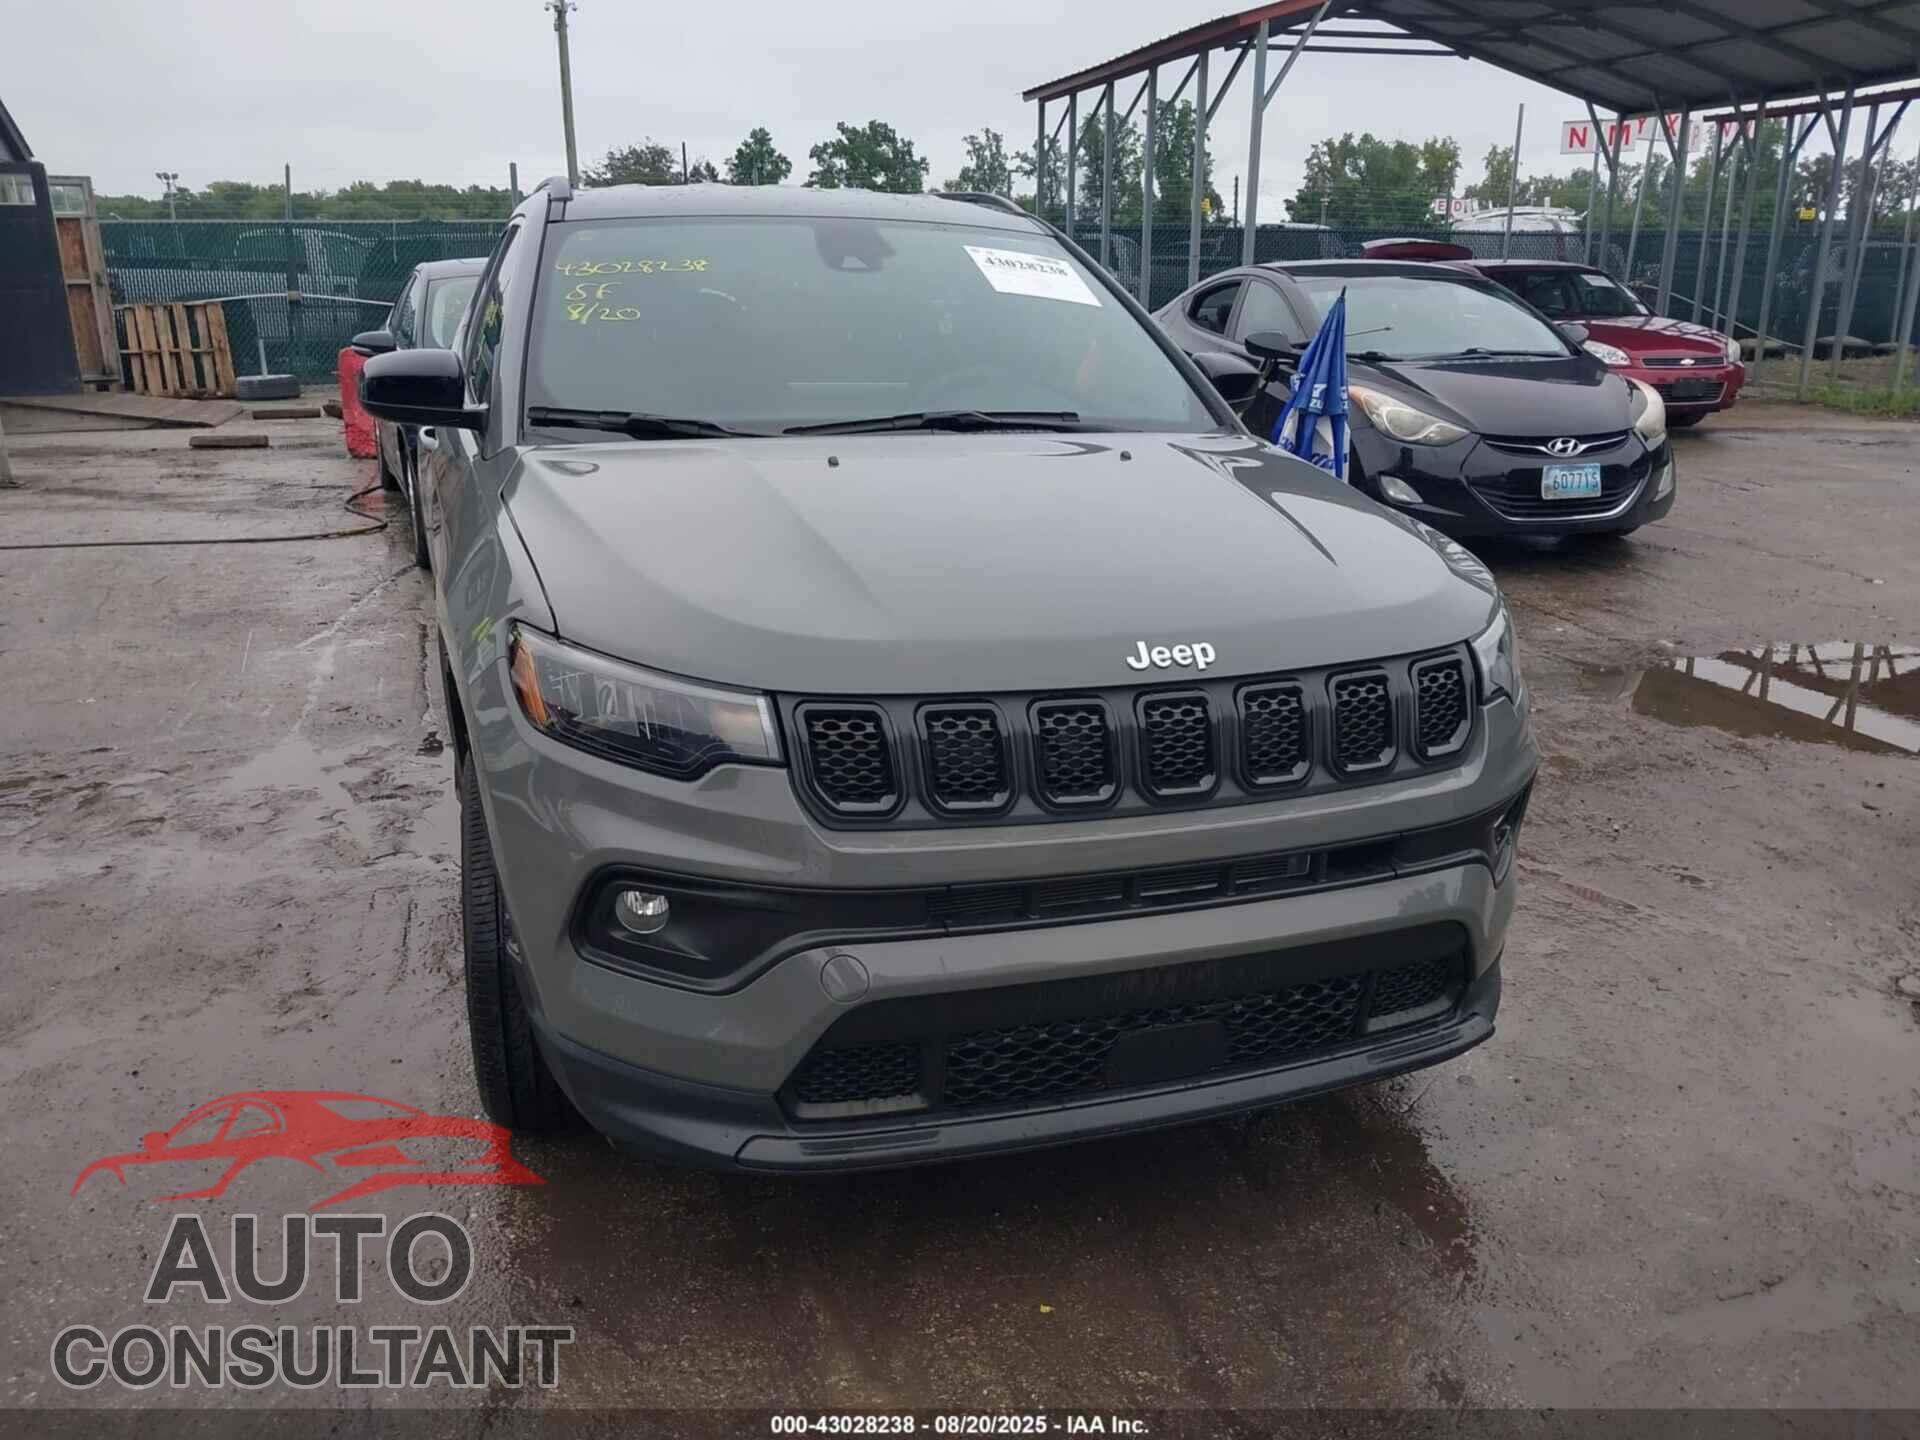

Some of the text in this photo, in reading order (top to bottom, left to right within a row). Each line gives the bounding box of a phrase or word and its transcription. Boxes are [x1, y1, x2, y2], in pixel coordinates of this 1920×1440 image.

[1569, 127, 1588, 148] N
[1608, 125, 1632, 146] M
[567, 302, 640, 324] 8/20
[1126, 640, 1216, 670] Jeep
